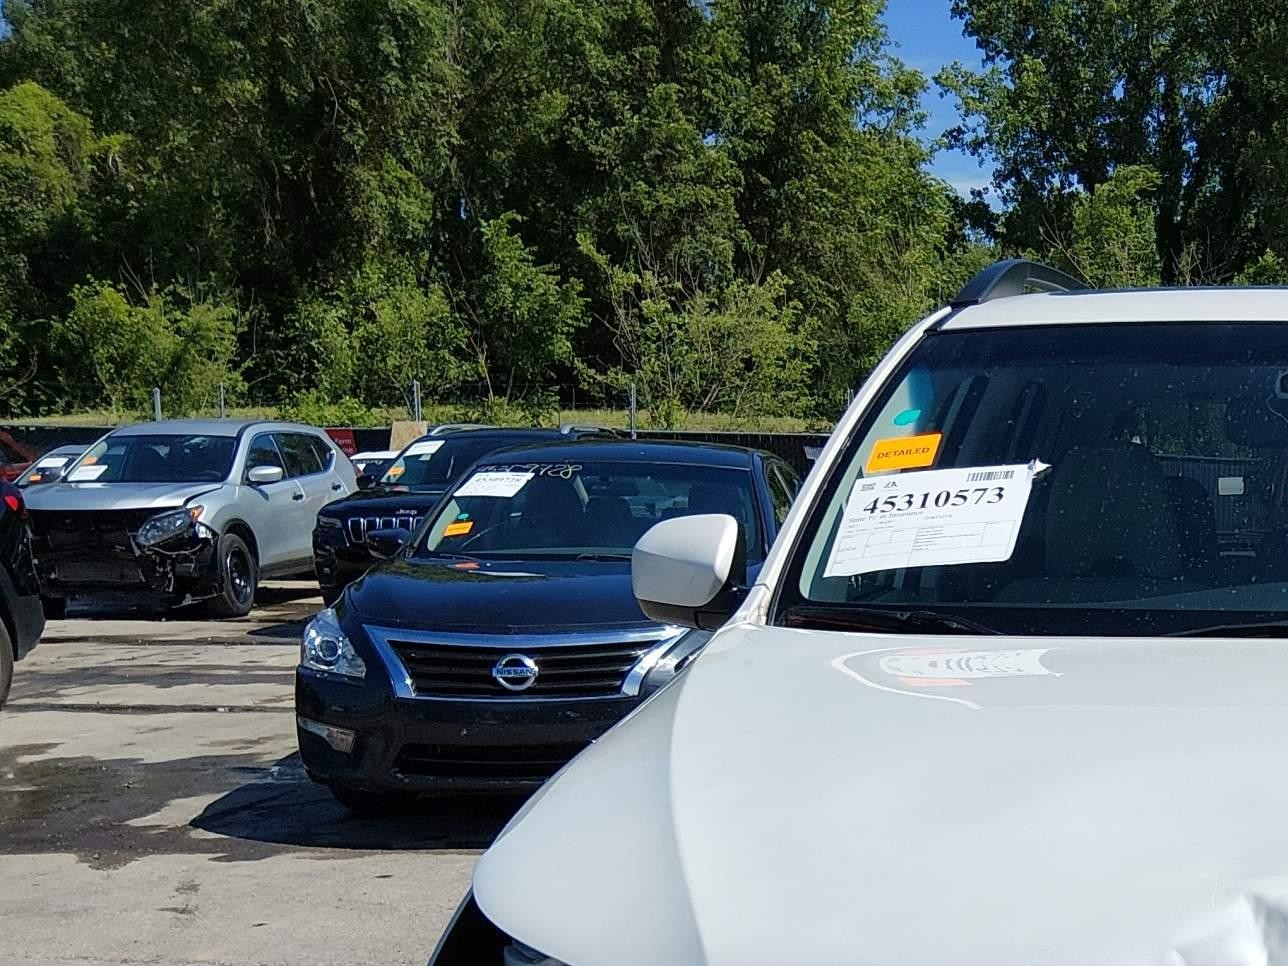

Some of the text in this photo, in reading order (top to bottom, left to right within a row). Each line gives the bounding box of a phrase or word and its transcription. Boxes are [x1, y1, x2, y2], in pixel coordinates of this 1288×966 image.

[877, 447, 930, 459] DETAILED
[863, 486, 1005, 515] 45310573
[496, 668, 536, 676] NISSAN
